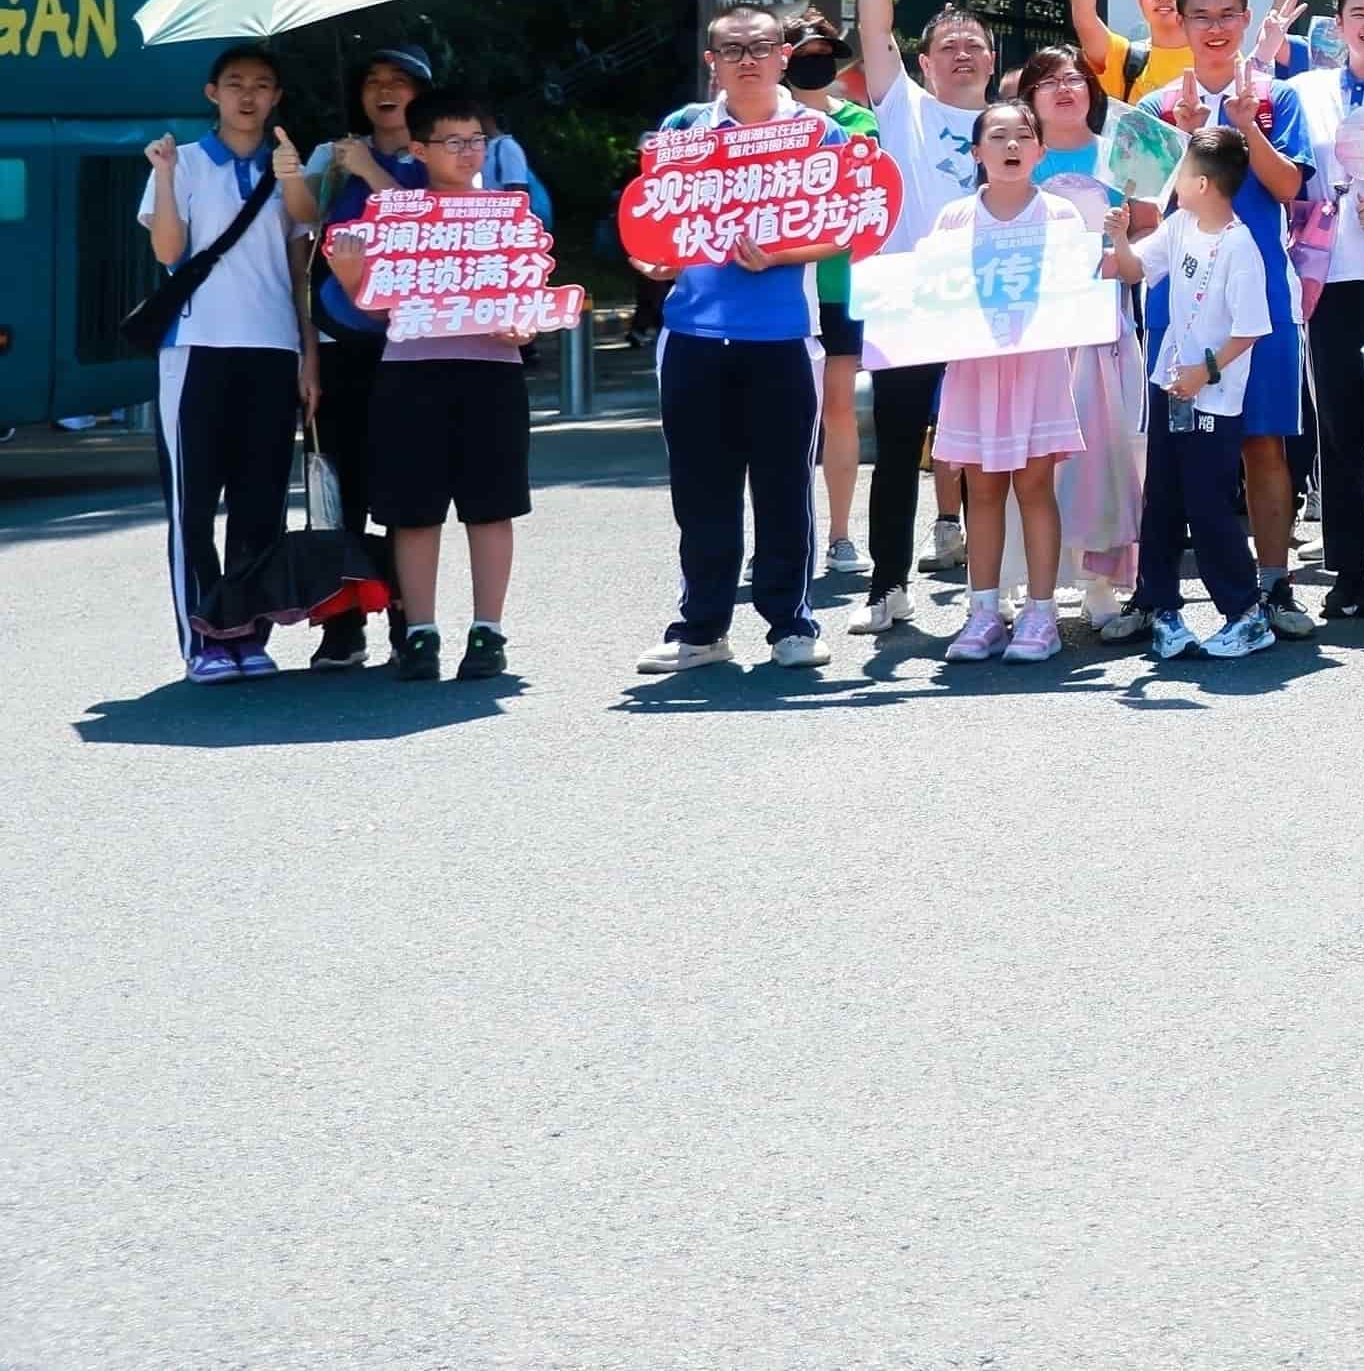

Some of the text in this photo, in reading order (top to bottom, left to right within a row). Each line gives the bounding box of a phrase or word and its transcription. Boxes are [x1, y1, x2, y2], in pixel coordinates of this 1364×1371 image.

[632, 151, 838, 221] 观澜湖游园
[673, 187, 888, 263] 快乐值已拉满
[362, 253, 550, 305] 解锁满分
